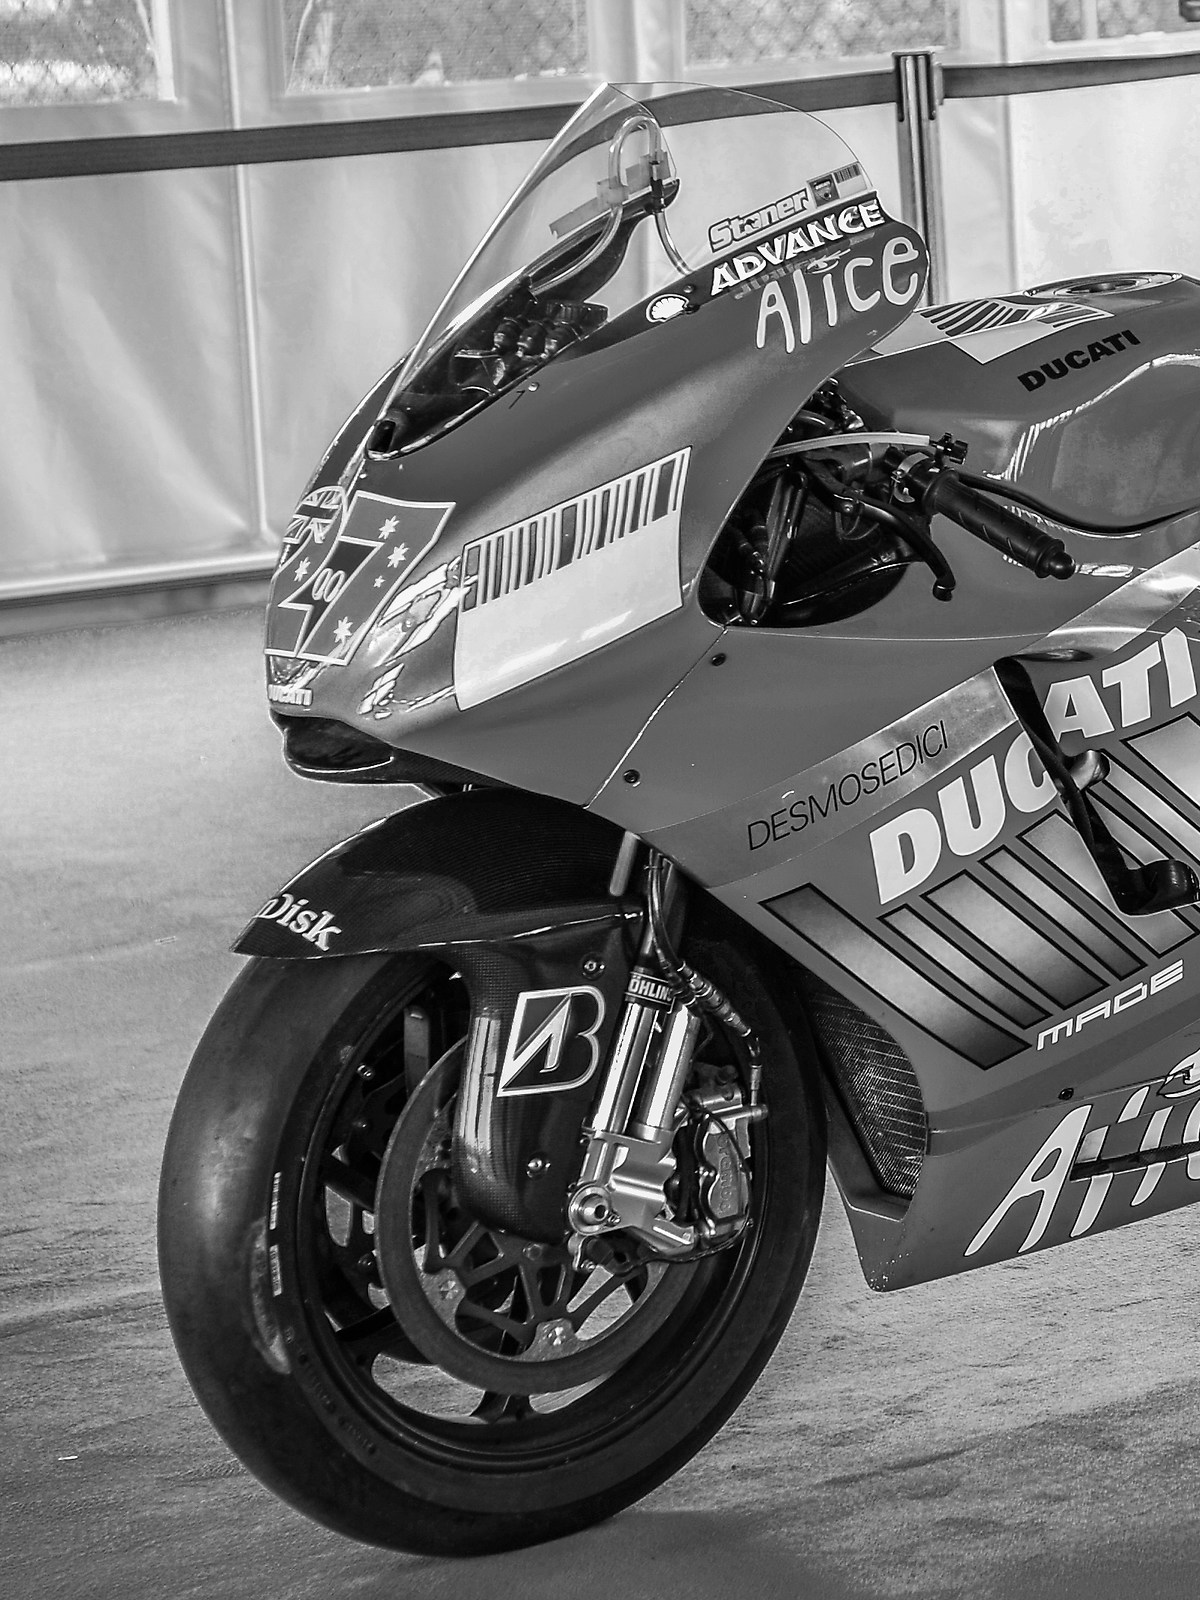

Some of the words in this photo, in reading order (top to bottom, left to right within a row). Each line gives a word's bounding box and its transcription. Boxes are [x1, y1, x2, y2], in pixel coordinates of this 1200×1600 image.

[708, 188, 810, 253] Stoner
[711, 199, 886, 296] ADVANCE
[756, 236, 920, 353] Alice
[1017, 330, 1141, 391] DUCATI
[747, 720, 948, 850] DESMOSEDICI
[868, 628, 1197, 904] DUCATI
[1037, 959, 1186, 1051] MADE
